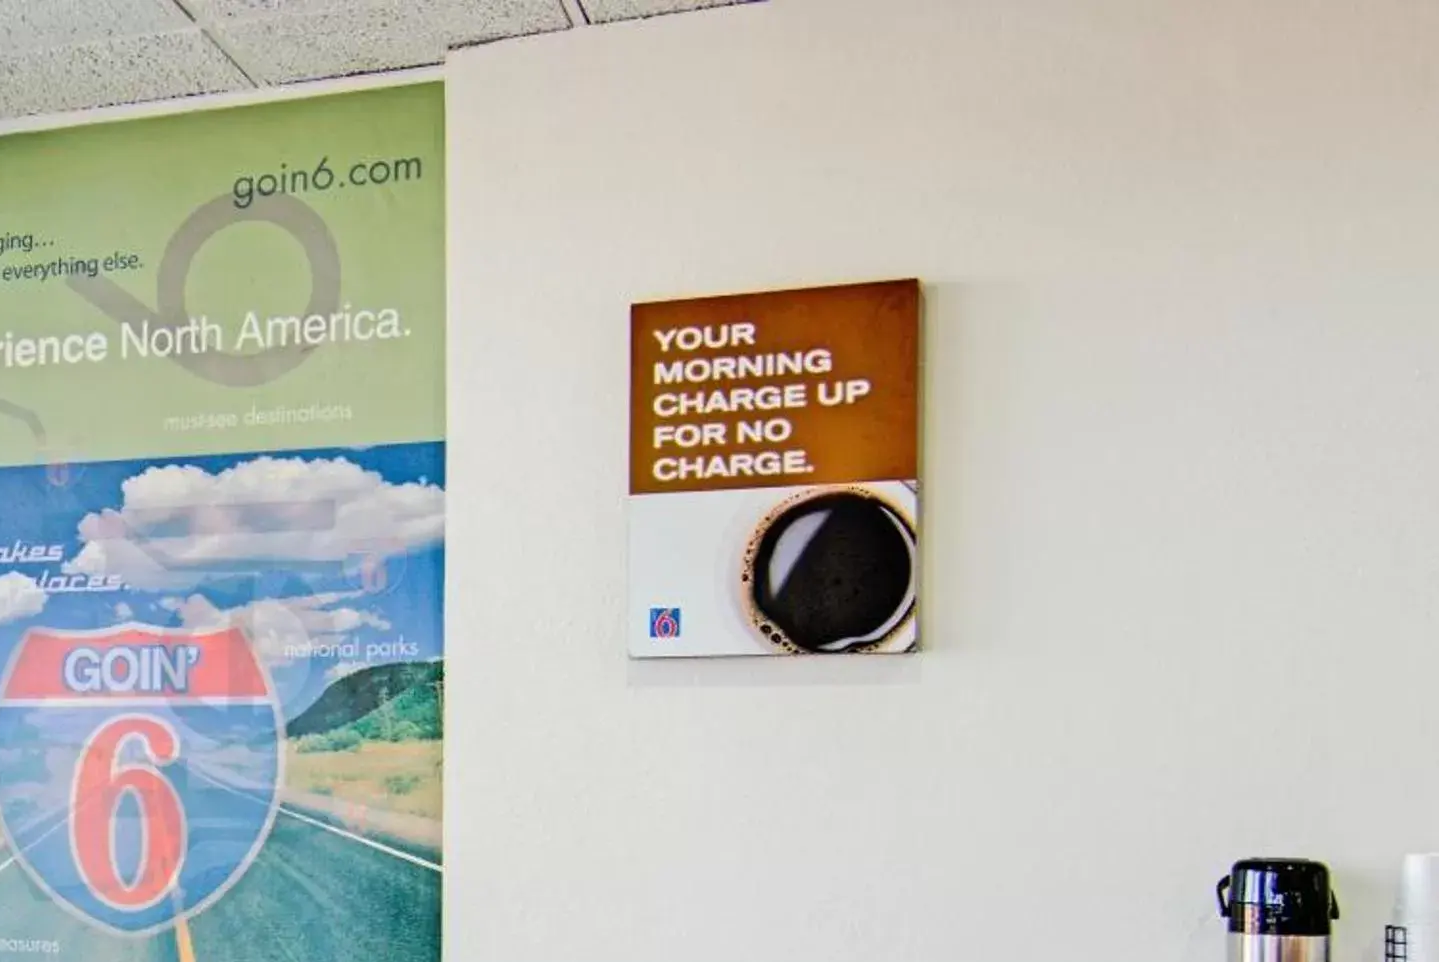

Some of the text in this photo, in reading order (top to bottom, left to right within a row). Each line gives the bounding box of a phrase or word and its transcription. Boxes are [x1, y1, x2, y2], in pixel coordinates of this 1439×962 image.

[233, 155, 423, 209] goin6.com
[2, 255, 98, 283] everything
[103, 251, 144, 271] else.
[121, 315, 222, 359] North
[234, 301, 412, 350] America.
[652, 322, 756, 352] YOUR
[653, 348, 832, 385] MORNING
[653, 379, 872, 417] CHARGE UP
[653, 417, 793, 449] FOR NO
[652, 449, 815, 481] CHARGE.
[284, 633, 420, 661] national parks
[62, 644, 201, 693] GOIN'
[69, 712, 188, 912] 6
